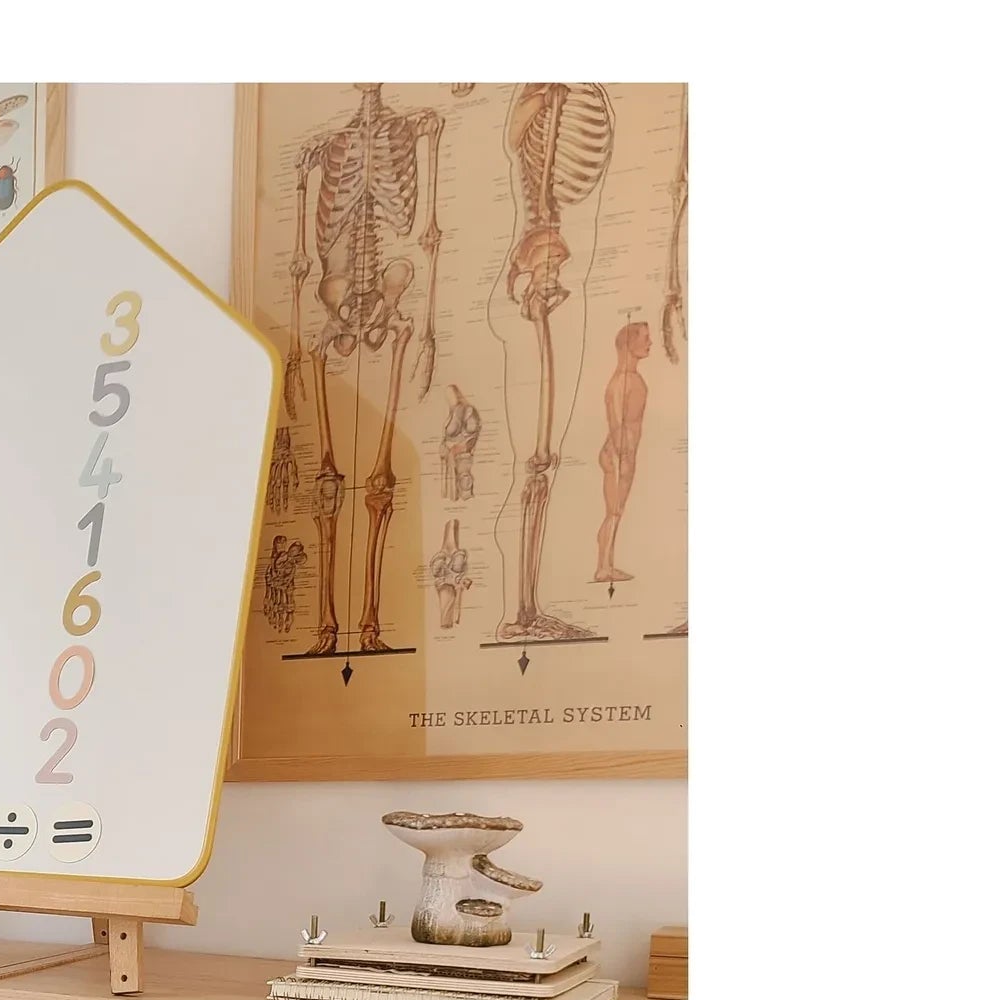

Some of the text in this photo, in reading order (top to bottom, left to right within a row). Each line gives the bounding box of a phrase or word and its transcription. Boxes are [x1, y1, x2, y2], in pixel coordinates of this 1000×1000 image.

[100, 290, 143, 357] 3
[88, 360, 131, 427] 5
[78, 432, 122, 500] 4
[77, 501, 105, 567] 1
[61, 570, 102, 637] 6
[48, 645, 96, 711] 0
[408, 704, 653, 728] THE SKELETAL SYSTEM
[35, 717, 79, 785] 2
